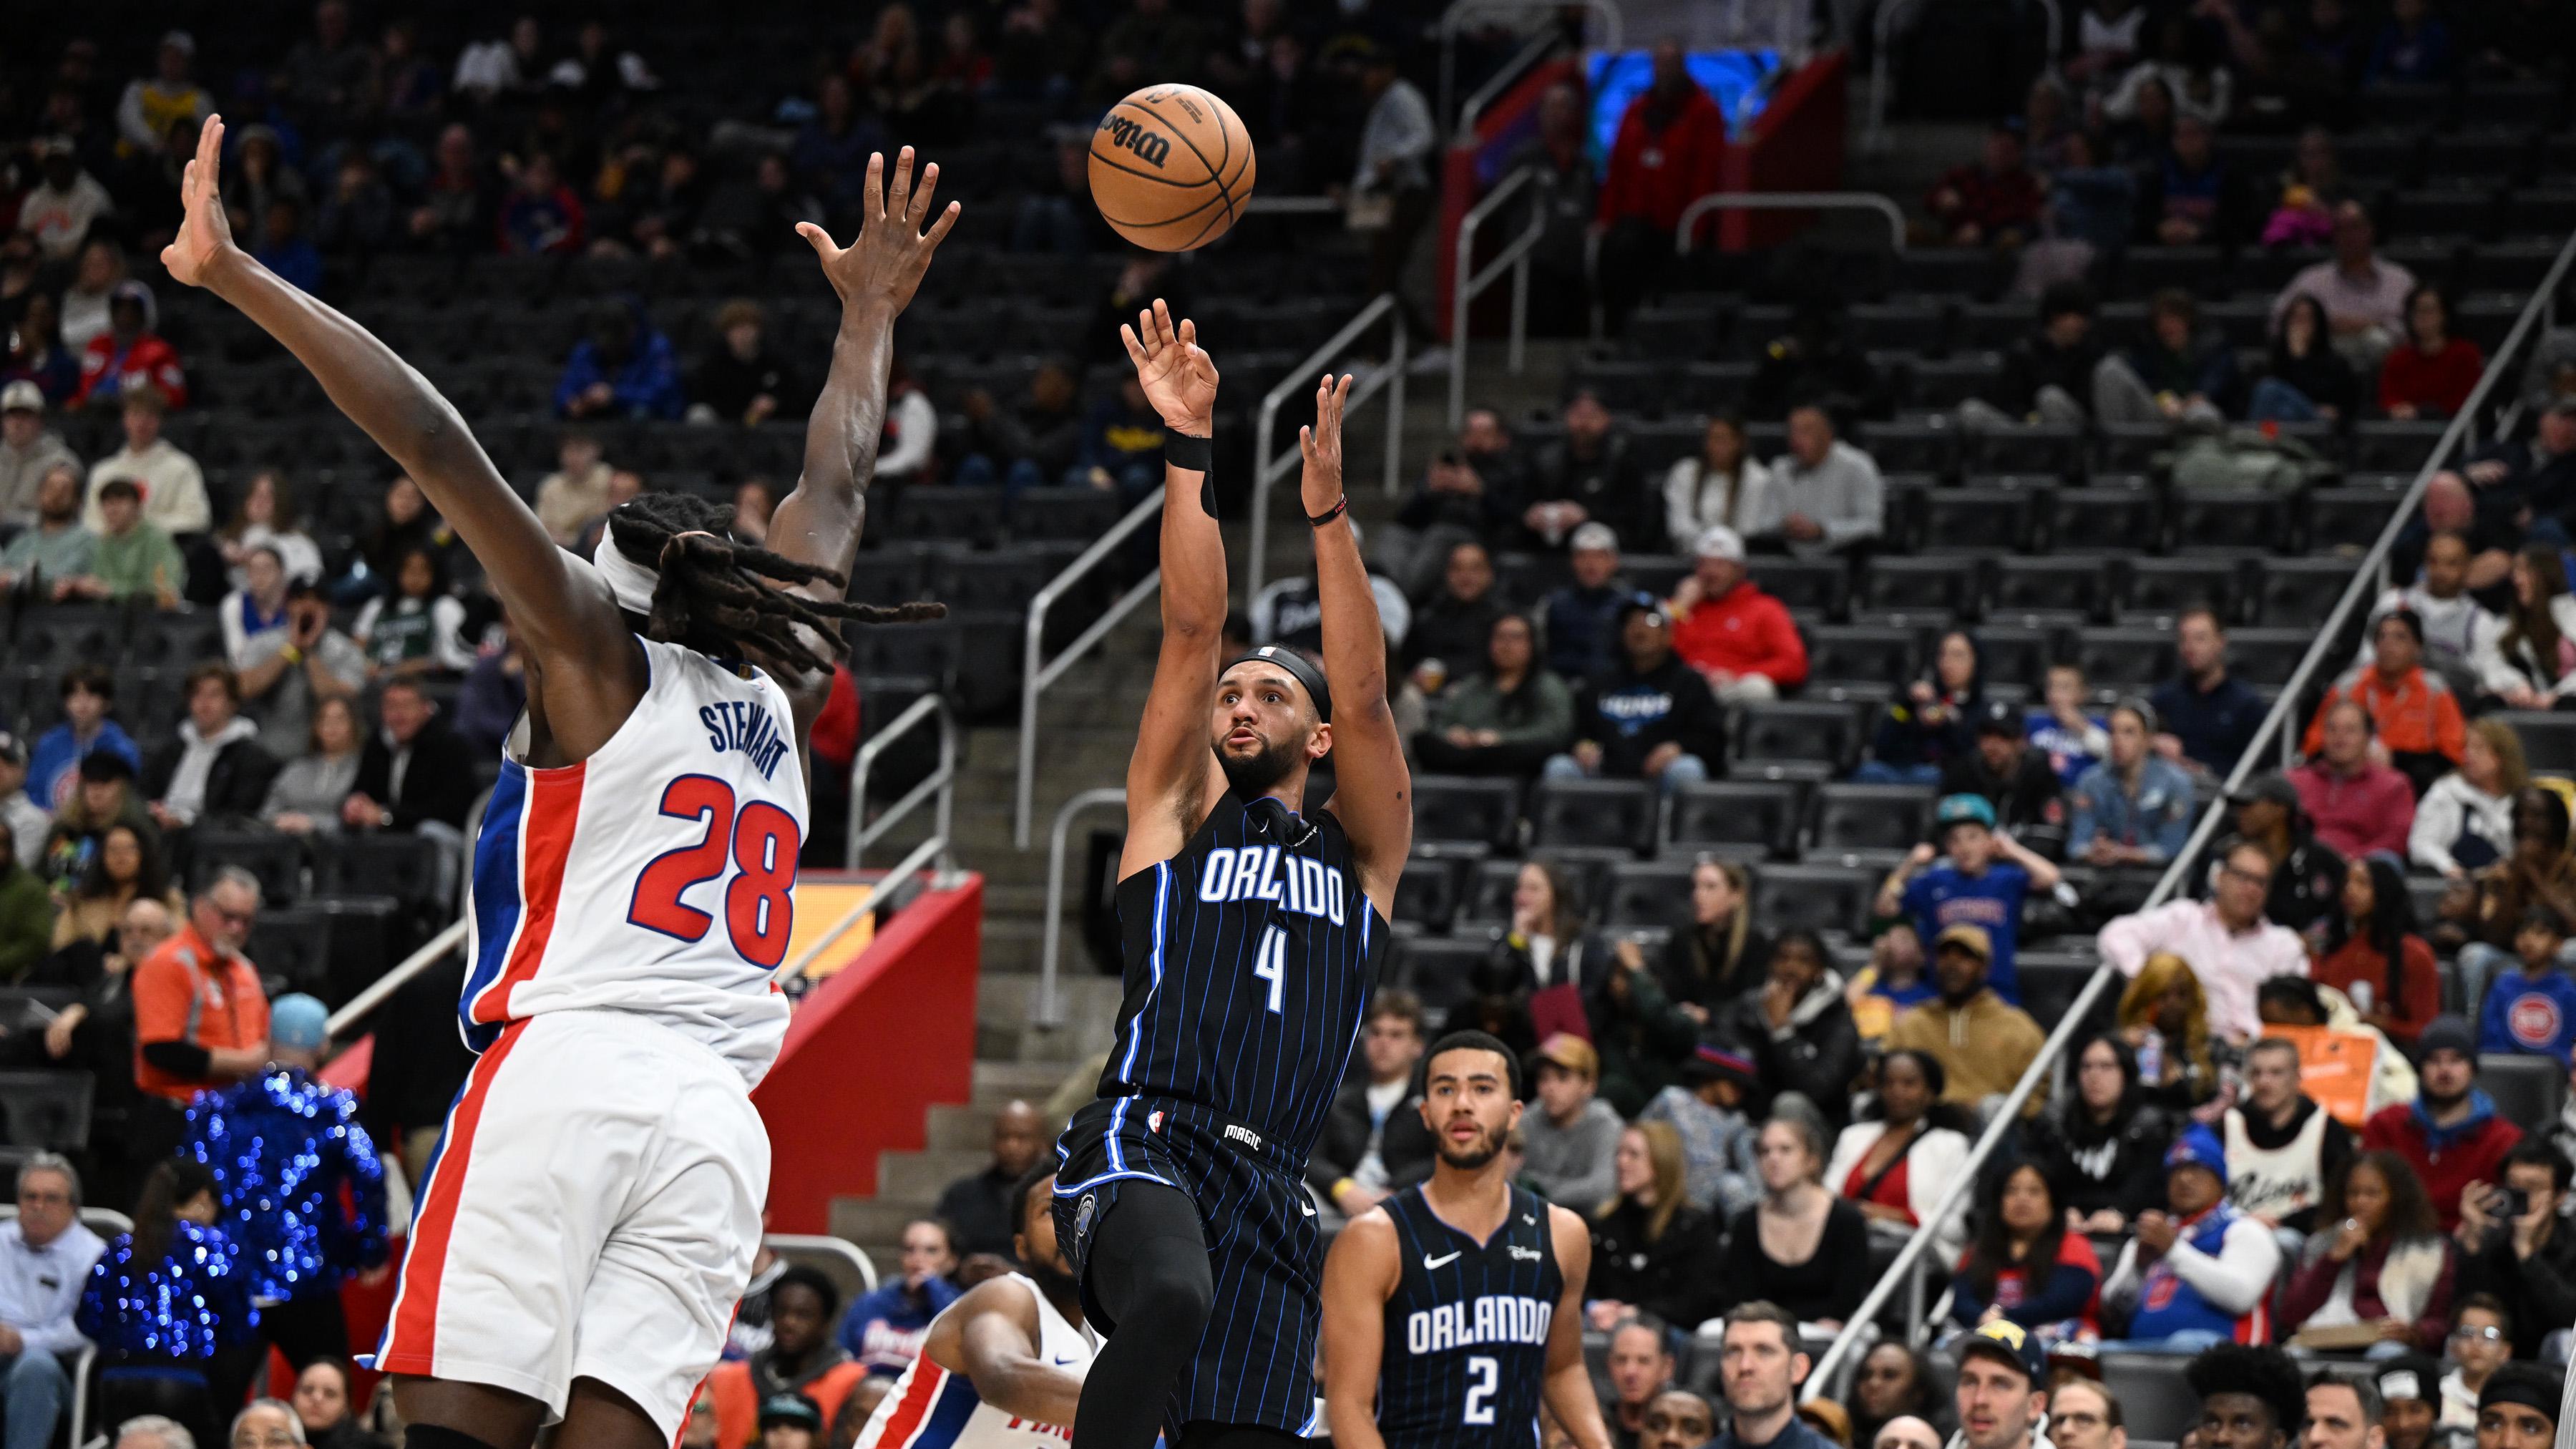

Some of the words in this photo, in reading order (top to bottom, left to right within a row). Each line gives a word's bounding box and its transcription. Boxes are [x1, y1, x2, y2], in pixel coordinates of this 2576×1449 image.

[698, 701, 789, 782] STEWART
[626, 773, 801, 970] 28
[1199, 844, 1345, 928] ORLNDO
[1254, 921, 1288, 1015] 4
[1224, 1124, 1262, 1151] MAGIC
[1407, 1294, 1553, 1355] ORLANDO
[1463, 1356, 1498, 1425] 2
